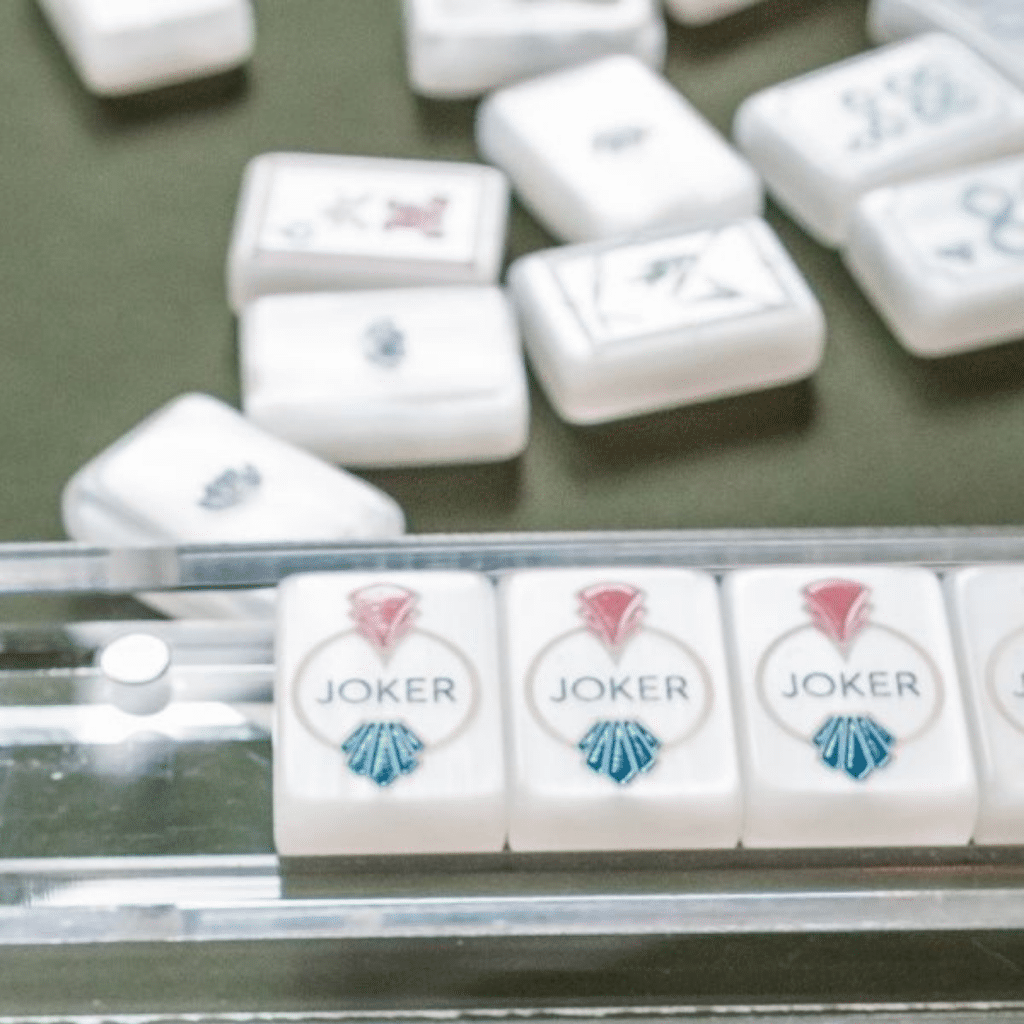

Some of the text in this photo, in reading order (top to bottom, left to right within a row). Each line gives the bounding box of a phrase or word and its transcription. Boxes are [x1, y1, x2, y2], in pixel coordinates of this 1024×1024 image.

[316, 676, 457, 703] JOKER
[549, 675, 690, 702] JOKER
[781, 671, 921, 698] JOKER
